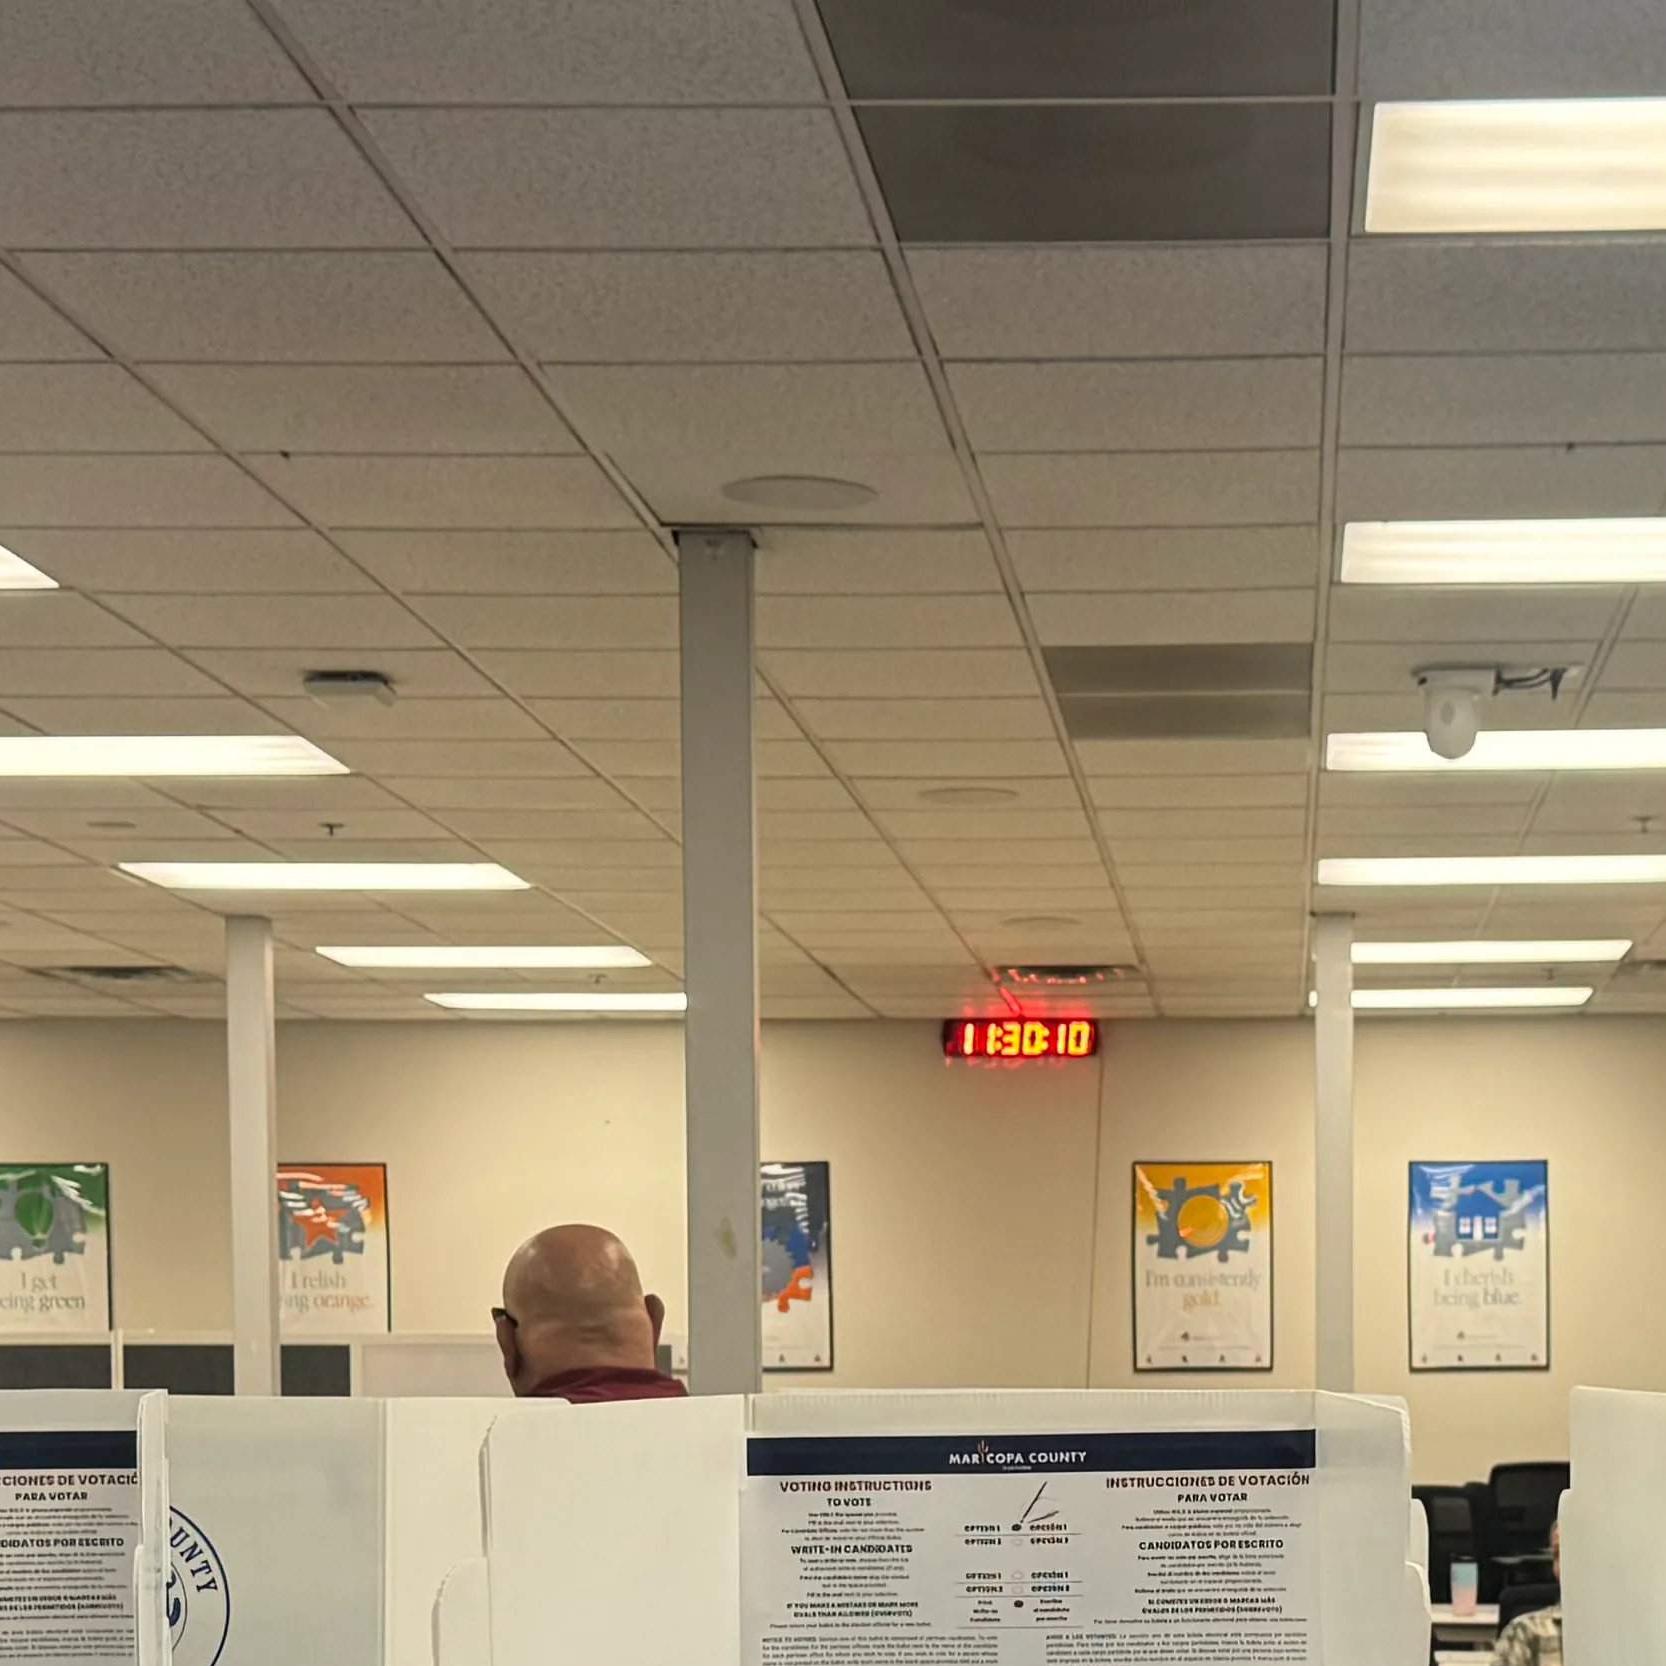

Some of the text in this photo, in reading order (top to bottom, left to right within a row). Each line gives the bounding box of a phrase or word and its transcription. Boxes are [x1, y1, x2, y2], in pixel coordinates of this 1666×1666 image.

[963, 1020, 1091, 1056] 11:30:10
[31, 1273, 58, 1294] get
[302, 1269, 346, 1290] relish
[1173, 1267, 1262, 1292] consistently
[1433, 1287, 1481, 1310] being
[949, 1446, 1087, 1464] MARICOPA COUNTY
[57, 1474, 75, 1486] DE
[780, 1480, 932, 1492] VOTING INSTRUCTIONS
[1106, 1471, 1310, 1489] INSTRUCCIONES DE VOTACIÓN
[15, 1491, 88, 1501] PARA VOTAR
[826, 1497, 872, 1507] TO VOTE
[1177, 1492, 1248, 1503] PARA VOTAR
[53, 1538, 77, 1548] POR
[78, 1537, 124, 1547] ESCRITO
[1139, 1538, 1284, 1550] CANDIDATOS POR ESCRITO
[791, 1544, 914, 1554] WRITE-IN CANDIDATES
